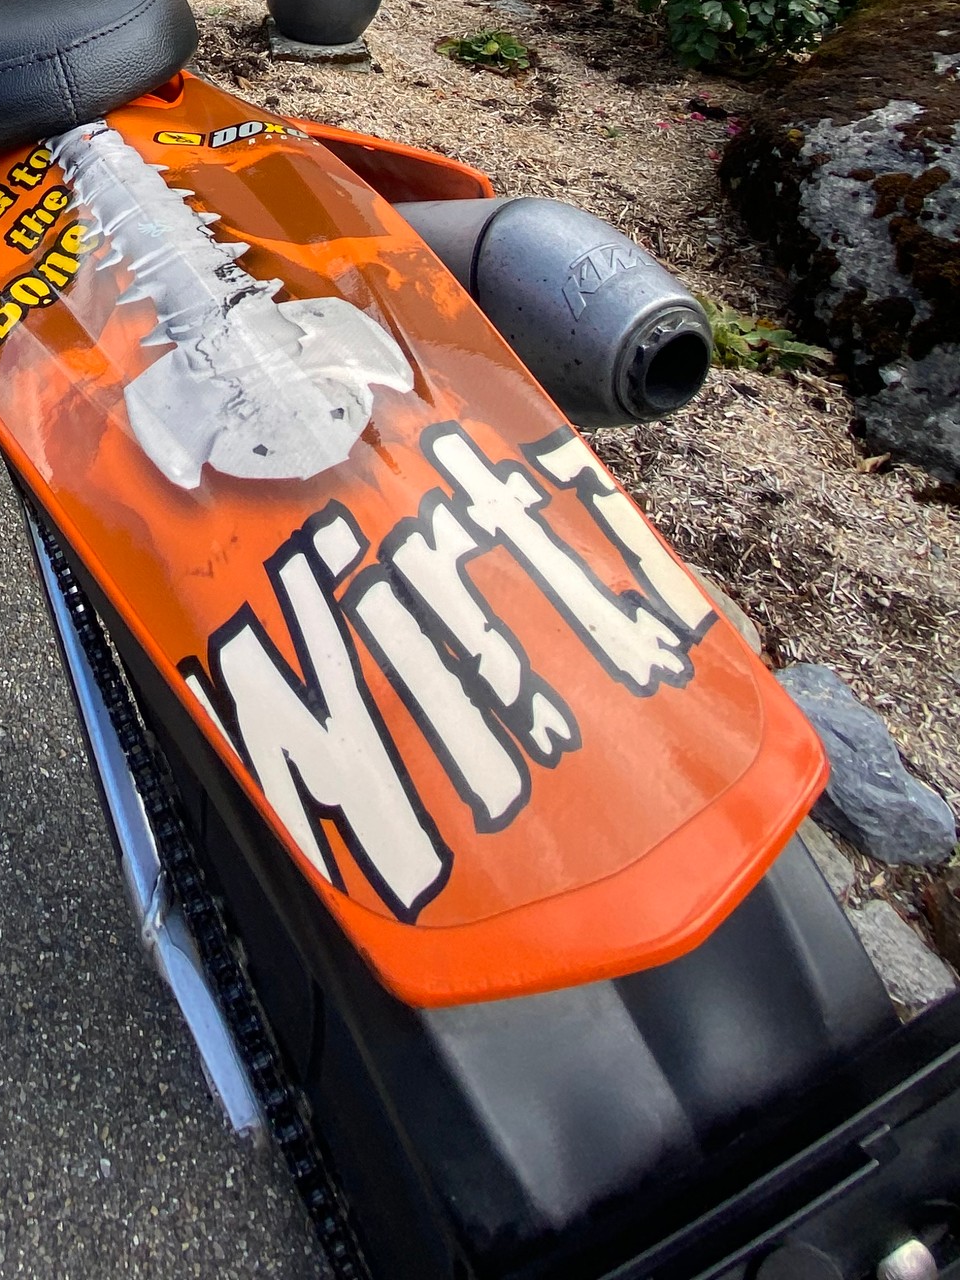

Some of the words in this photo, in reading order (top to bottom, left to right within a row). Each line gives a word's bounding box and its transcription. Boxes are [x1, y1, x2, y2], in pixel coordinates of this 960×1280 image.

[7, 139, 62, 191] to
[4, 186, 77, 255] the
[561, 242, 658, 322] KTM
